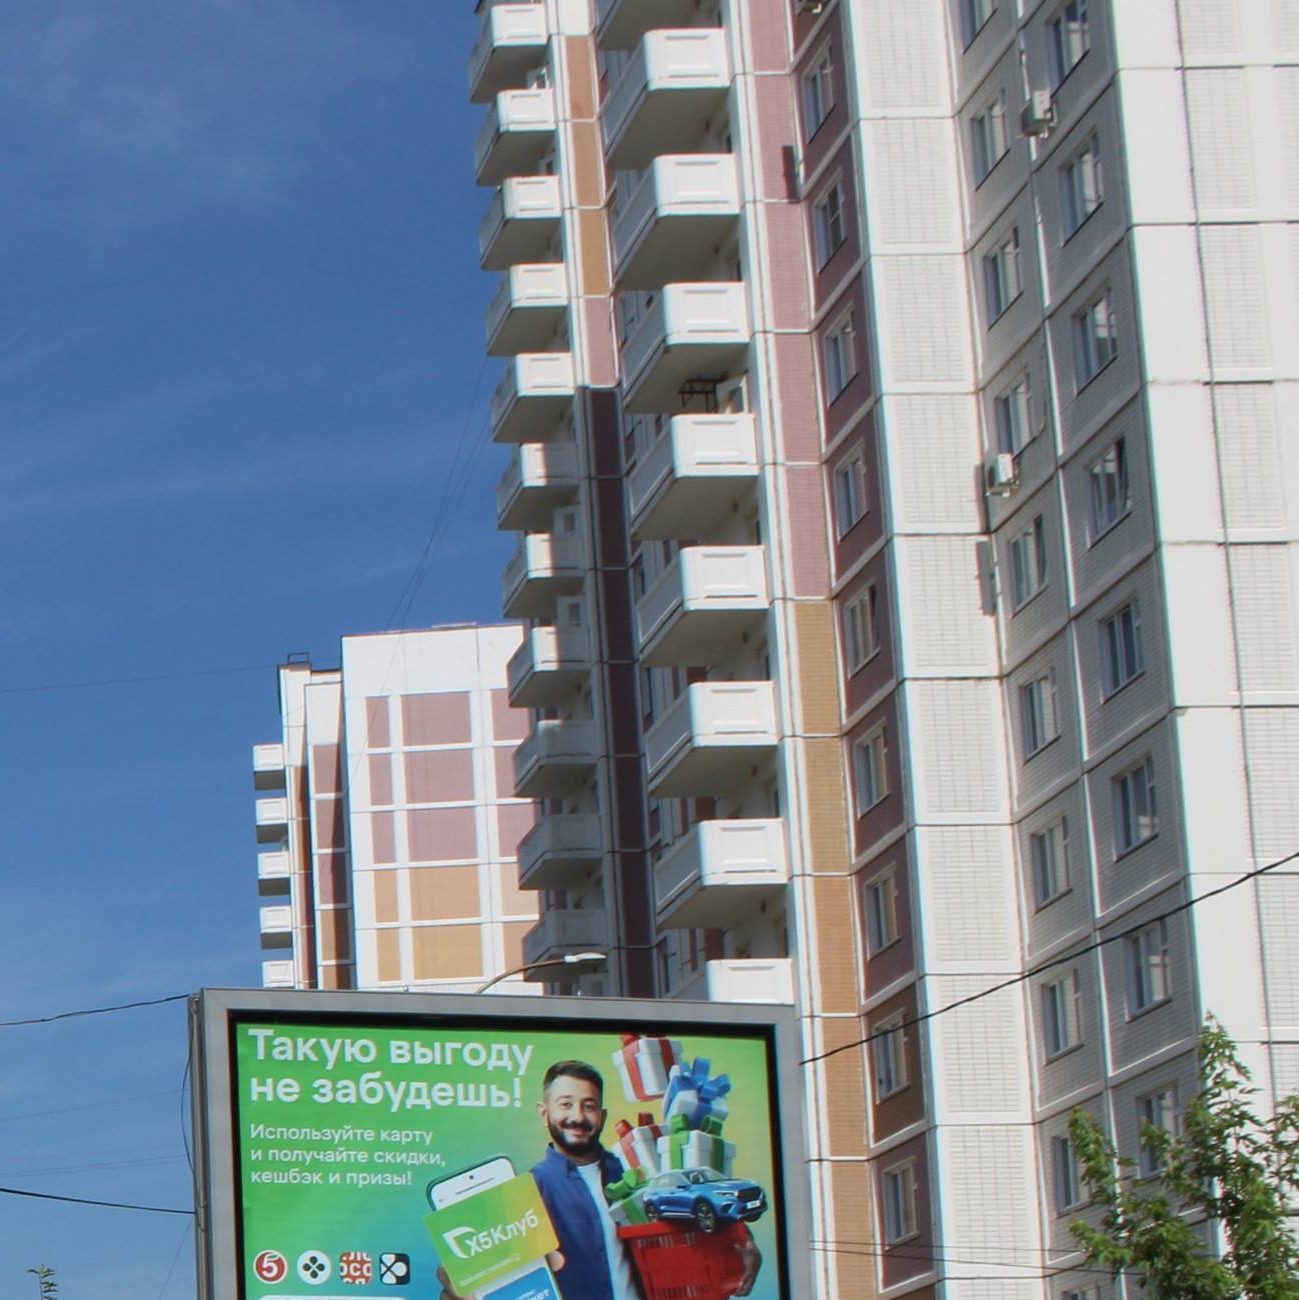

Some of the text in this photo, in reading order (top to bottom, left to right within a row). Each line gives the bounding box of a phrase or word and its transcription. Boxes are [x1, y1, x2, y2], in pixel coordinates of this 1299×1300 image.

[248, 1028, 534, 1075] Такую выгоду
[250, 1071, 523, 1112] не забудешь!
[250, 1123, 433, 1147] Используйте карту
[250, 1148, 447, 1168] и получайте скидки,
[250, 1169, 413, 1188] кешбэк и призы!
